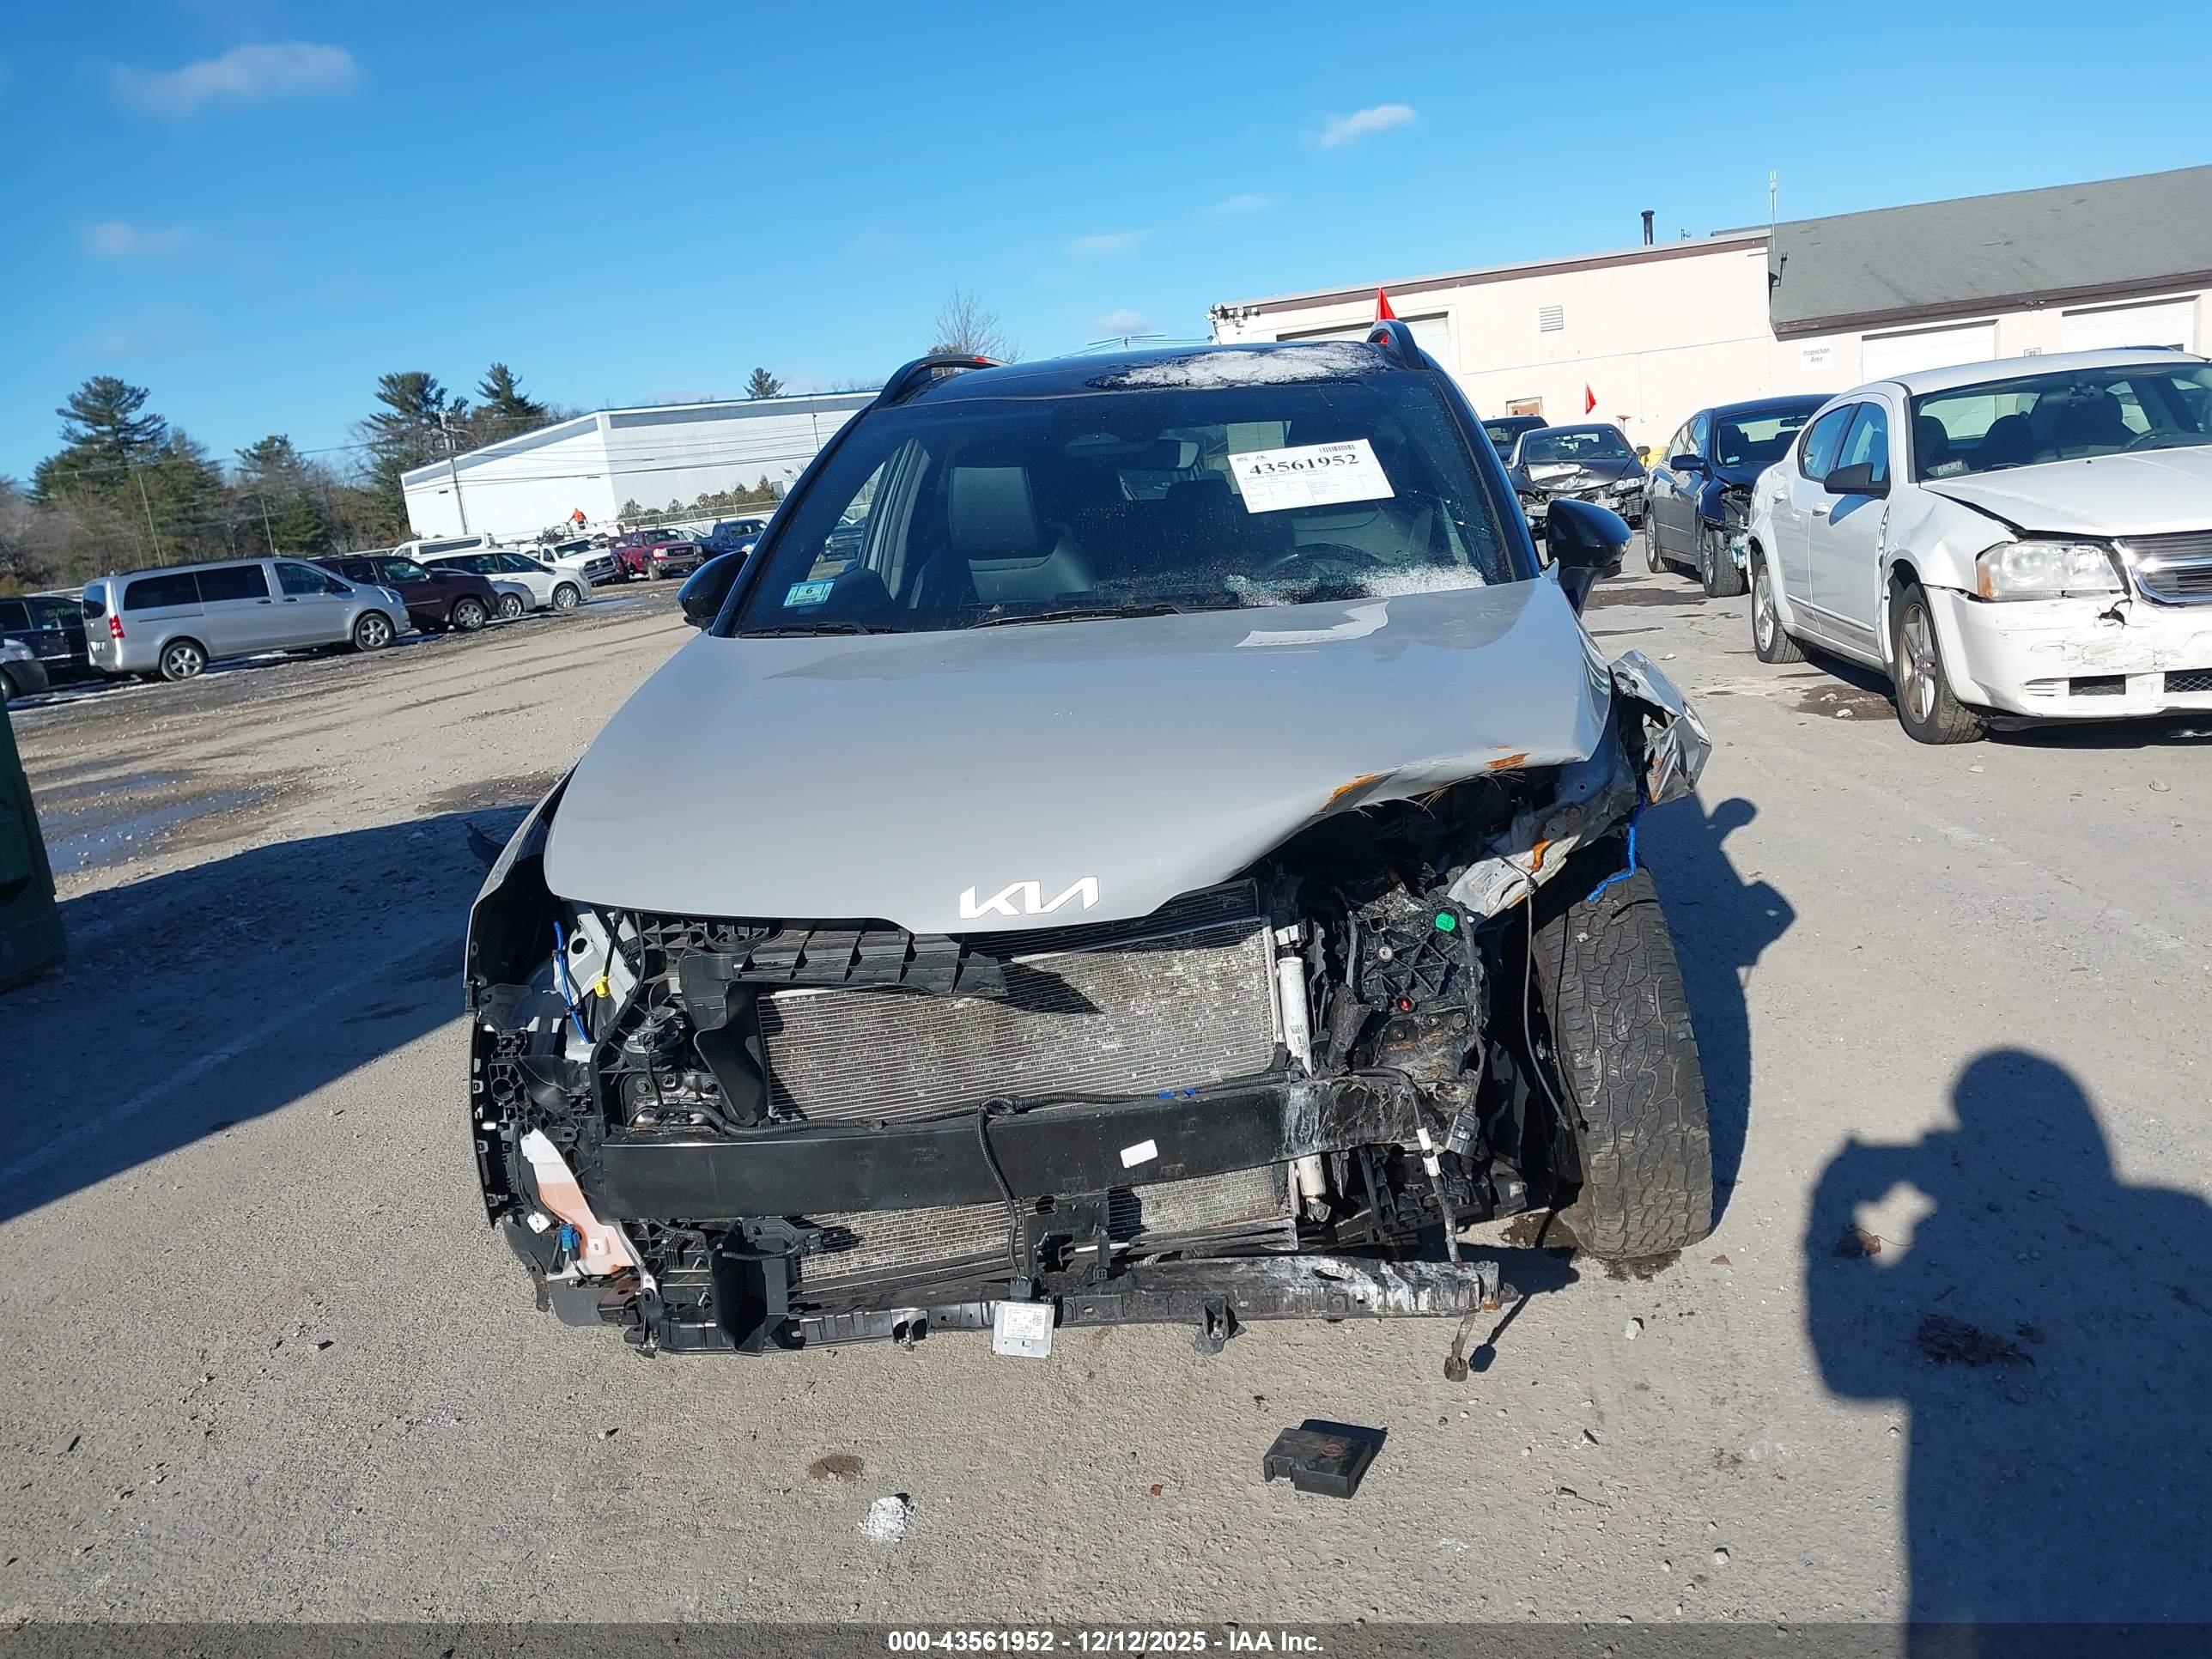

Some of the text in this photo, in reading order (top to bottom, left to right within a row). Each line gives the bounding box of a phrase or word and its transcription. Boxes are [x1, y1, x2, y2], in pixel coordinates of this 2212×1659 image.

[1802, 348, 1830, 356] Inspection
[1249, 453, 1359, 475] 43561952
[959, 876, 1100, 920] KIA
